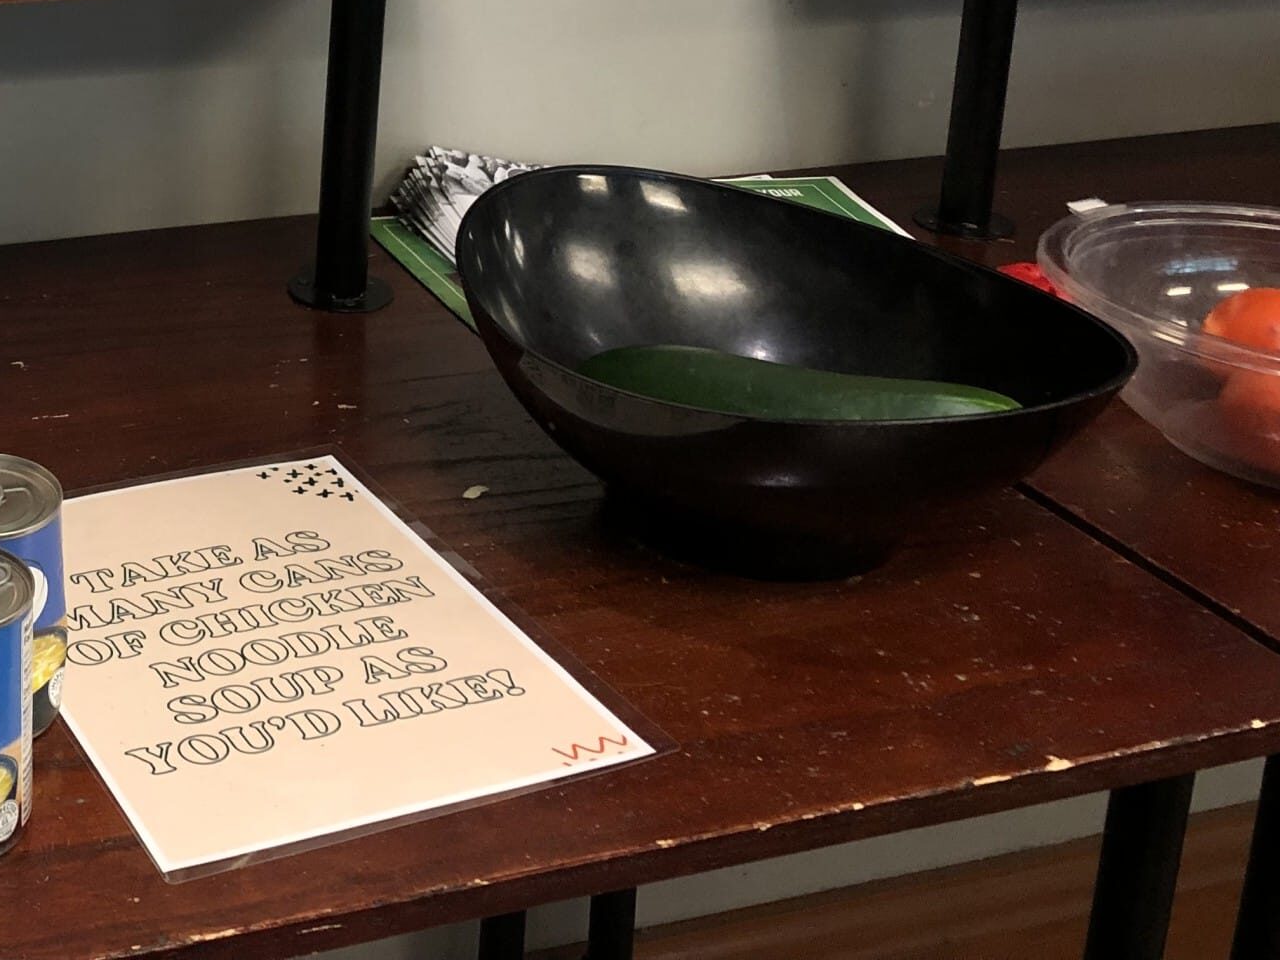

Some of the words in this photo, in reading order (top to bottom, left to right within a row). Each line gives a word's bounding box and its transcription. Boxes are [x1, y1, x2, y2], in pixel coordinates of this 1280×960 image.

[71, 544, 244, 594] TAKE
[253, 530, 331, 563] AS
[239, 548, 405, 595] CANS
[65, 629, 147, 666] OF
[159, 576, 435, 646] CHICKEN
[148, 616, 408, 690] NOODLE
[125, 708, 342, 776] YOU'D
[343, 667, 528, 728] LIKE!
[166, 665, 345, 725] SOUP
[363, 645, 449, 685] AS
